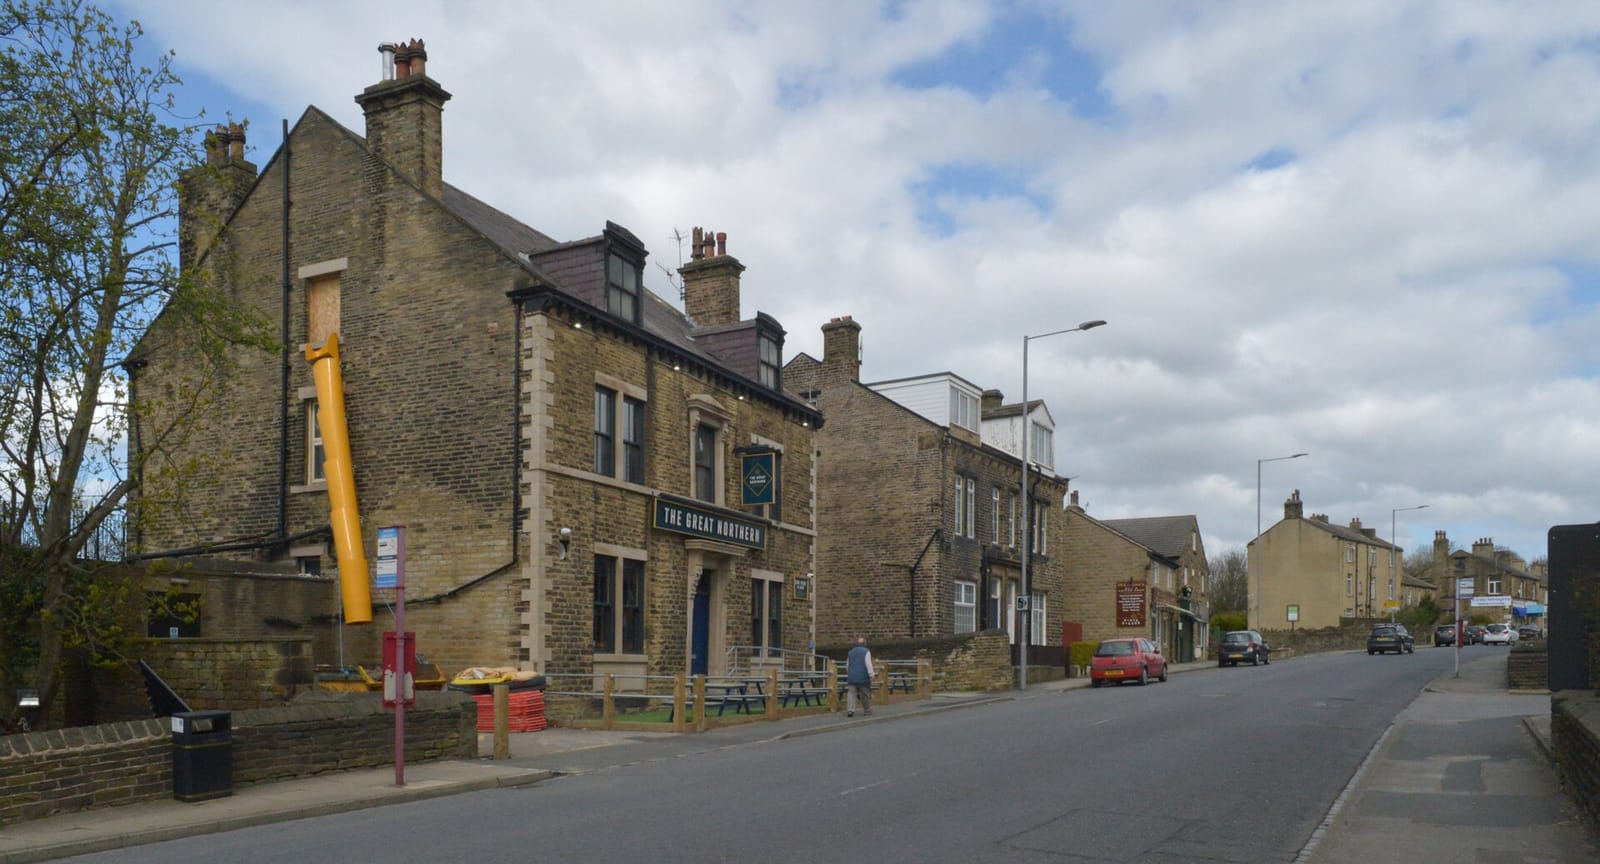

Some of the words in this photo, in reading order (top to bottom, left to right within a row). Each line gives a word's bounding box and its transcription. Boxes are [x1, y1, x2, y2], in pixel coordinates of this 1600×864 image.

[664, 507, 682, 526] THE
[686, 512, 714, 533] GREAT
[717, 519, 760, 543] NORTHERN
